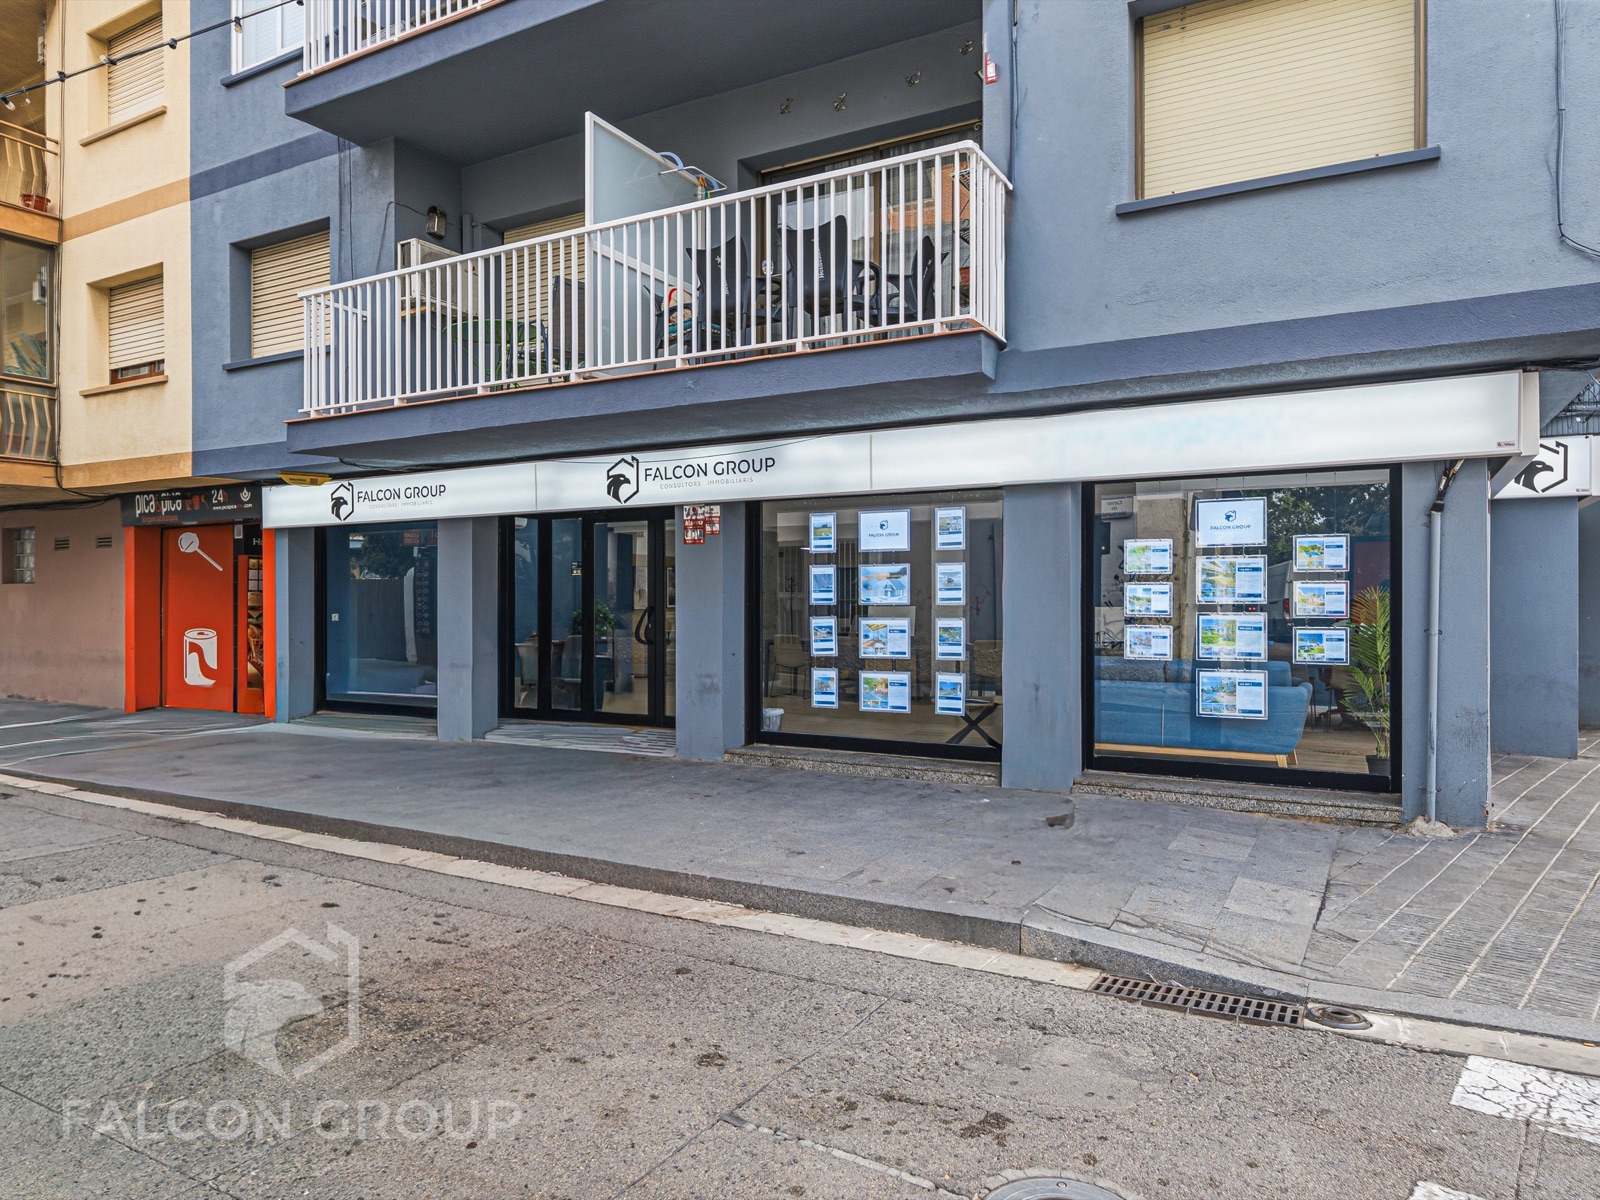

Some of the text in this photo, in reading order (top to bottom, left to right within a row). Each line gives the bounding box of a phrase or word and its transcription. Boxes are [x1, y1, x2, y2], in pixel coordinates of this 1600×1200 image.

[644, 457, 776, 482] FALCON GROUP
[659, 476, 754, 490] CONSULTORS IMMOBILIARIS
[357, 484, 446, 503] FALCON GROUP
